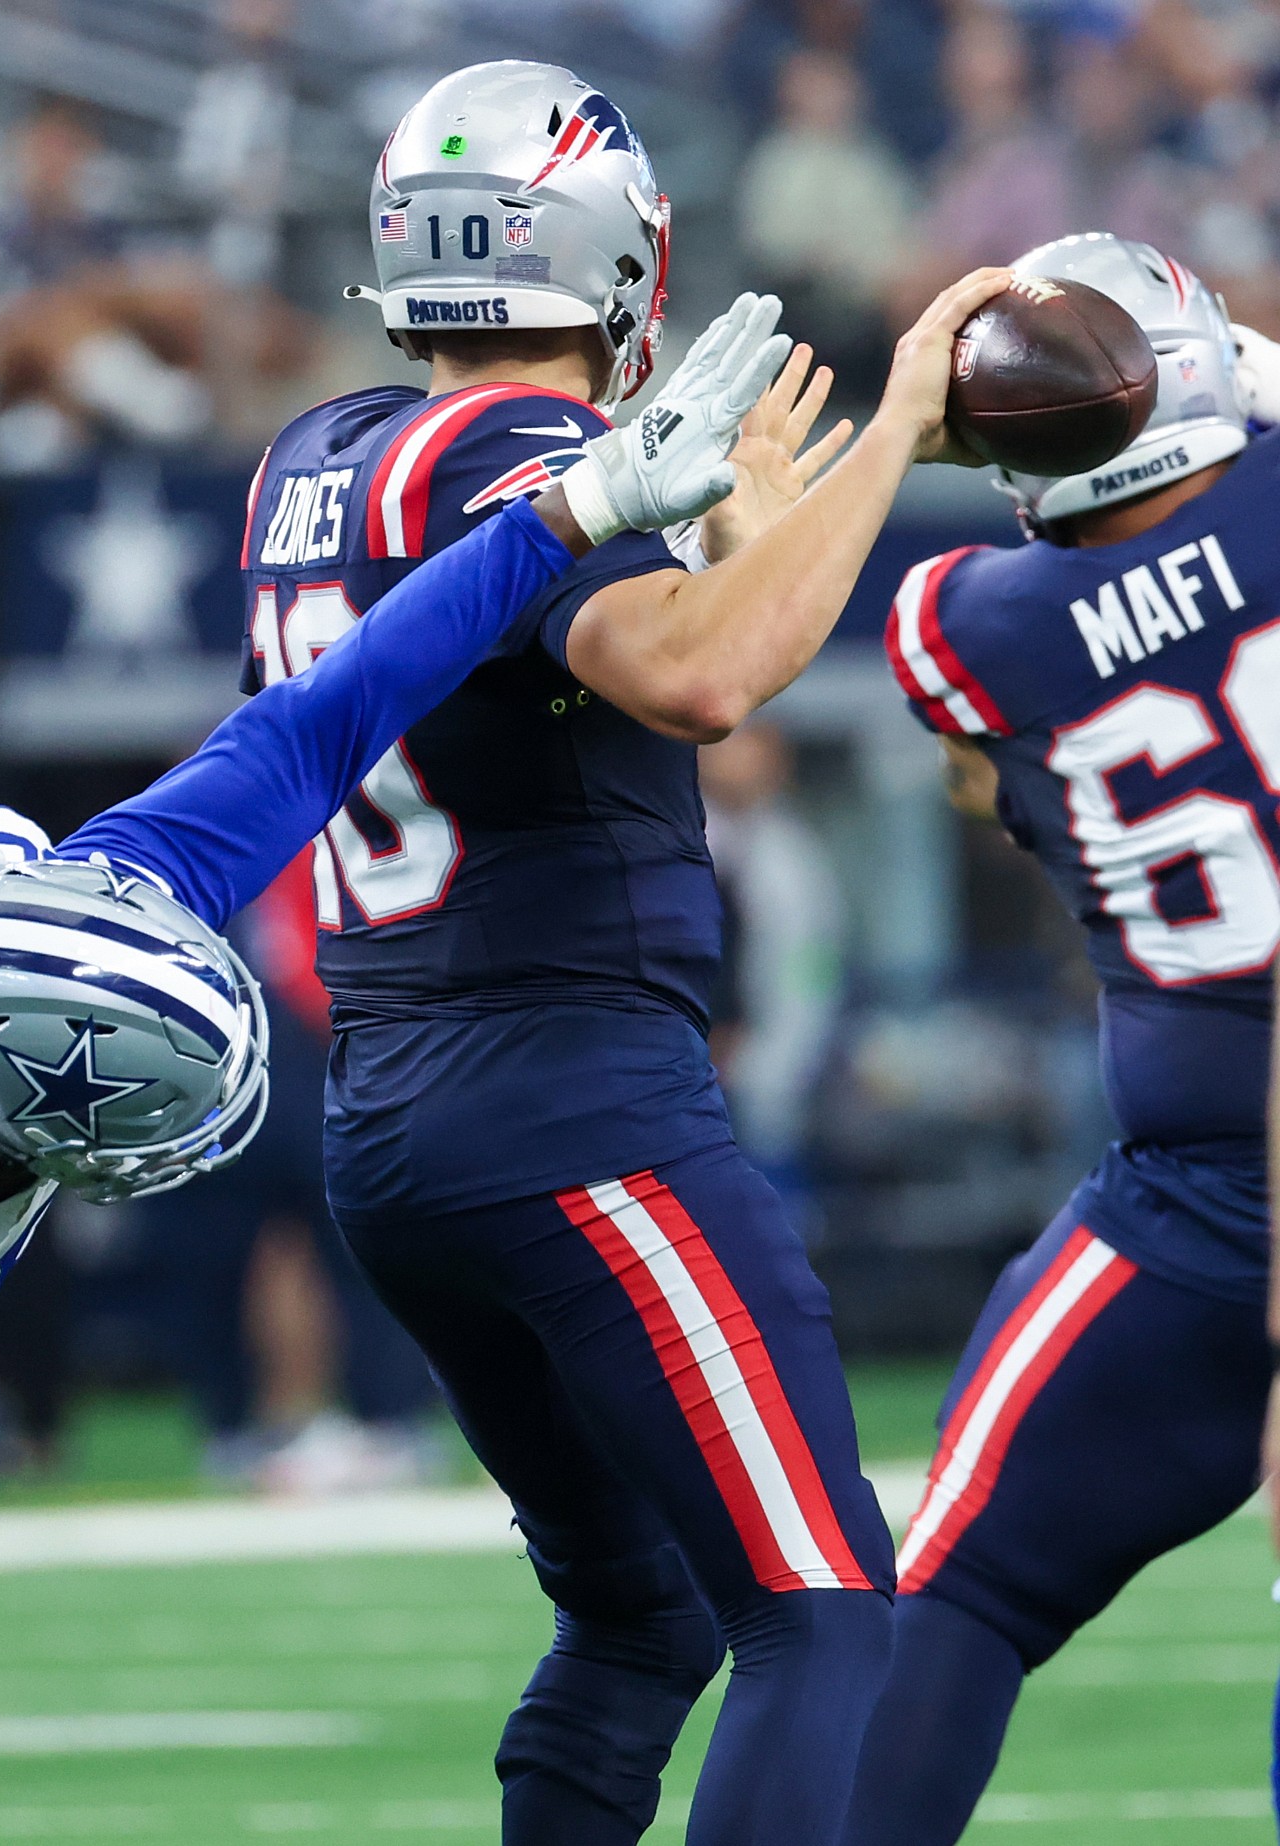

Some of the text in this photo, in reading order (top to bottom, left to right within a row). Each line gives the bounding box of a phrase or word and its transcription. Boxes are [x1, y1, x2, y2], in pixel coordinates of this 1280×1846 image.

[427, 215, 489, 260] 10
[508, 228, 530, 244] NFL
[406, 297, 509, 324] PATRIOTS
[642, 408, 658, 461] adidas
[1091, 446, 1190, 498] PATRIOTS
[260, 468, 354, 566] JONES
[1069, 534, 1246, 680] MAFI
